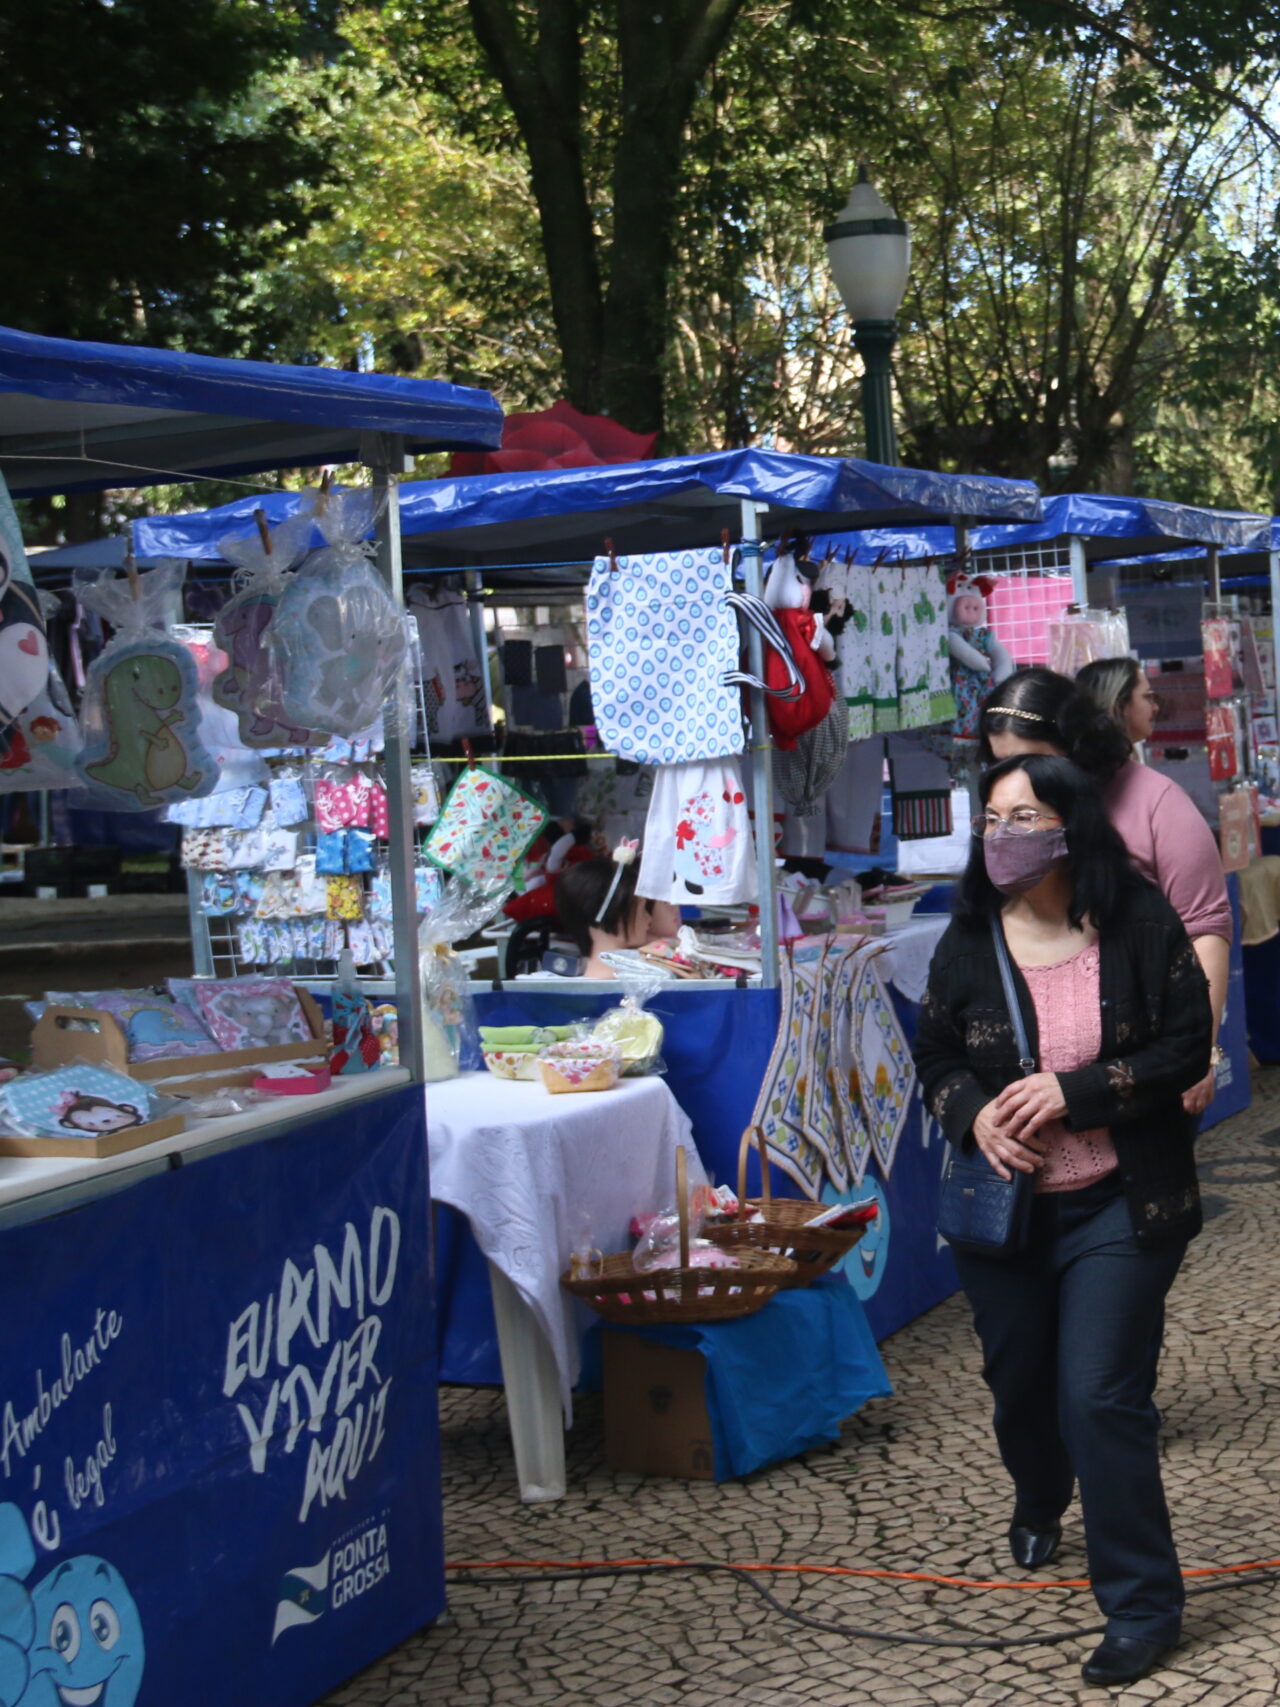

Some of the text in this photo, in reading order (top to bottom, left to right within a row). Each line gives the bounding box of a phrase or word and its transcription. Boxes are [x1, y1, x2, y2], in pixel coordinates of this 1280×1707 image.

[236, 1314, 382, 1474] VIVER
[64, 1402, 116, 1511] legal
[298, 1376, 393, 1523] AQUI
[331, 1522, 388, 1581] PONTA
[331, 1550, 391, 1610] GROSSA
